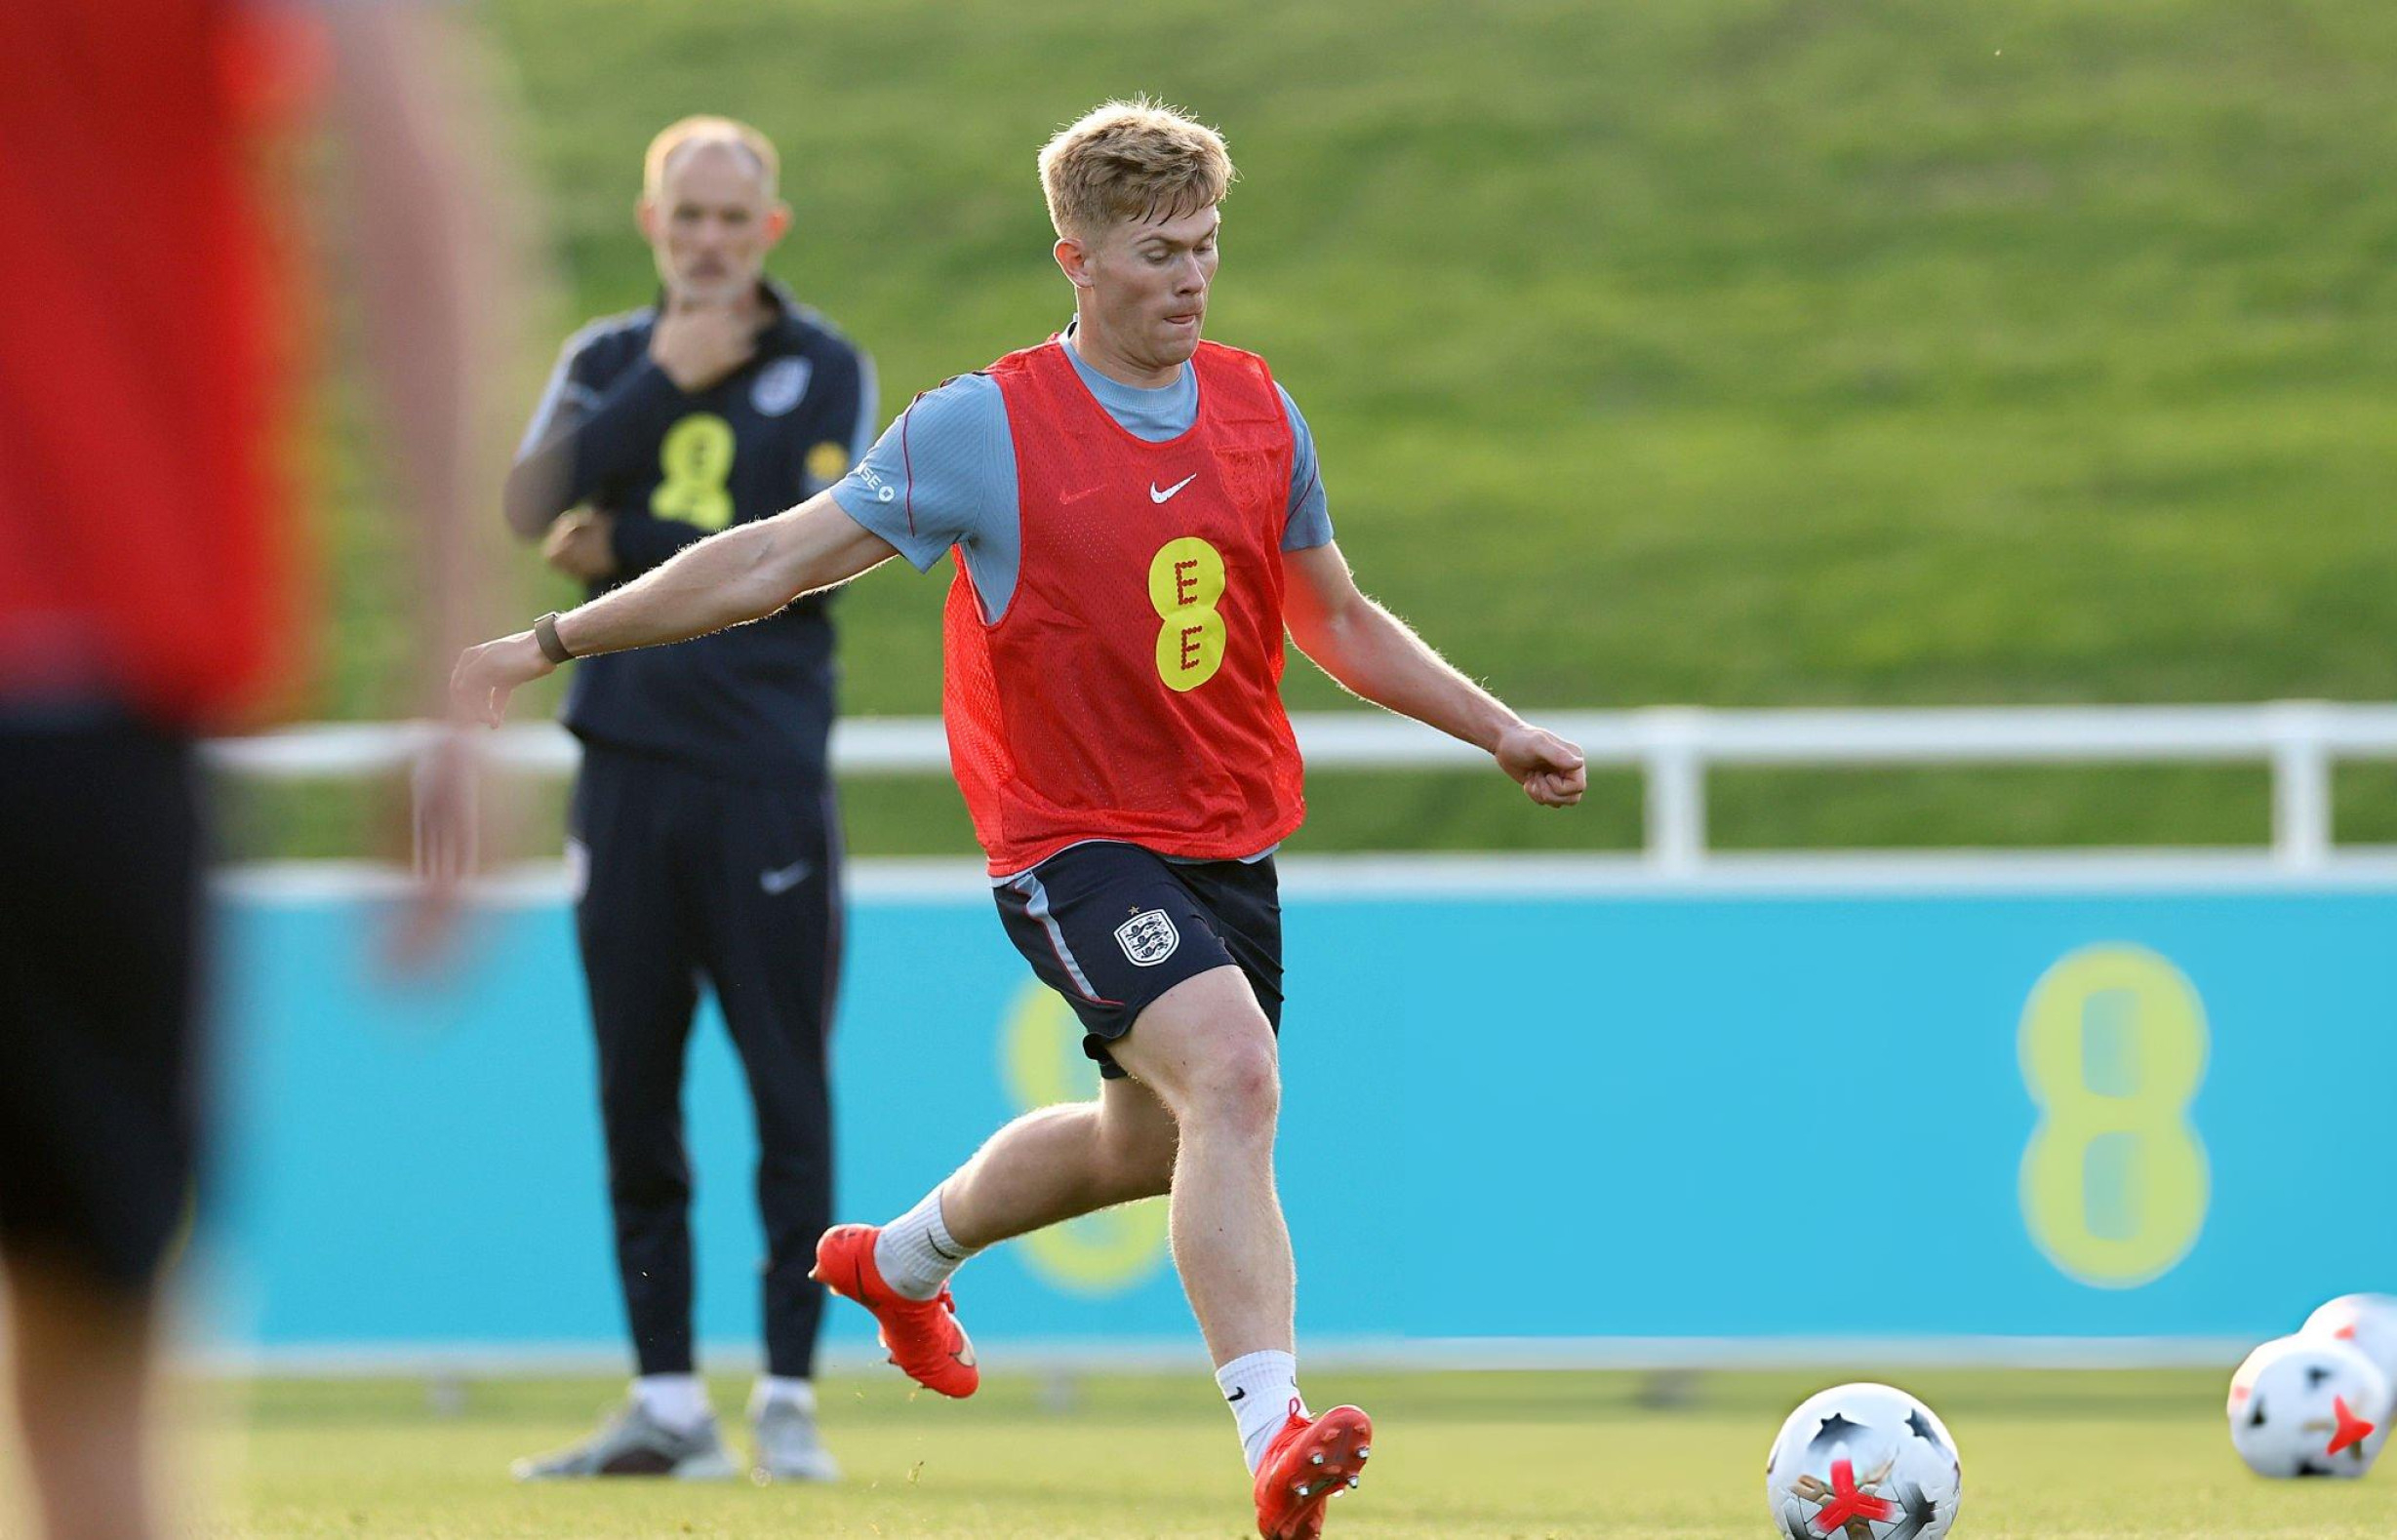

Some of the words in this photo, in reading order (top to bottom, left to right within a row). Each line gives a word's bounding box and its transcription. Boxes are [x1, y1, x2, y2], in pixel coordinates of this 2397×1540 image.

[857, 463, 882, 492] SE
[1175, 559, 1198, 606] E
[1180, 625, 1203, 671] E
